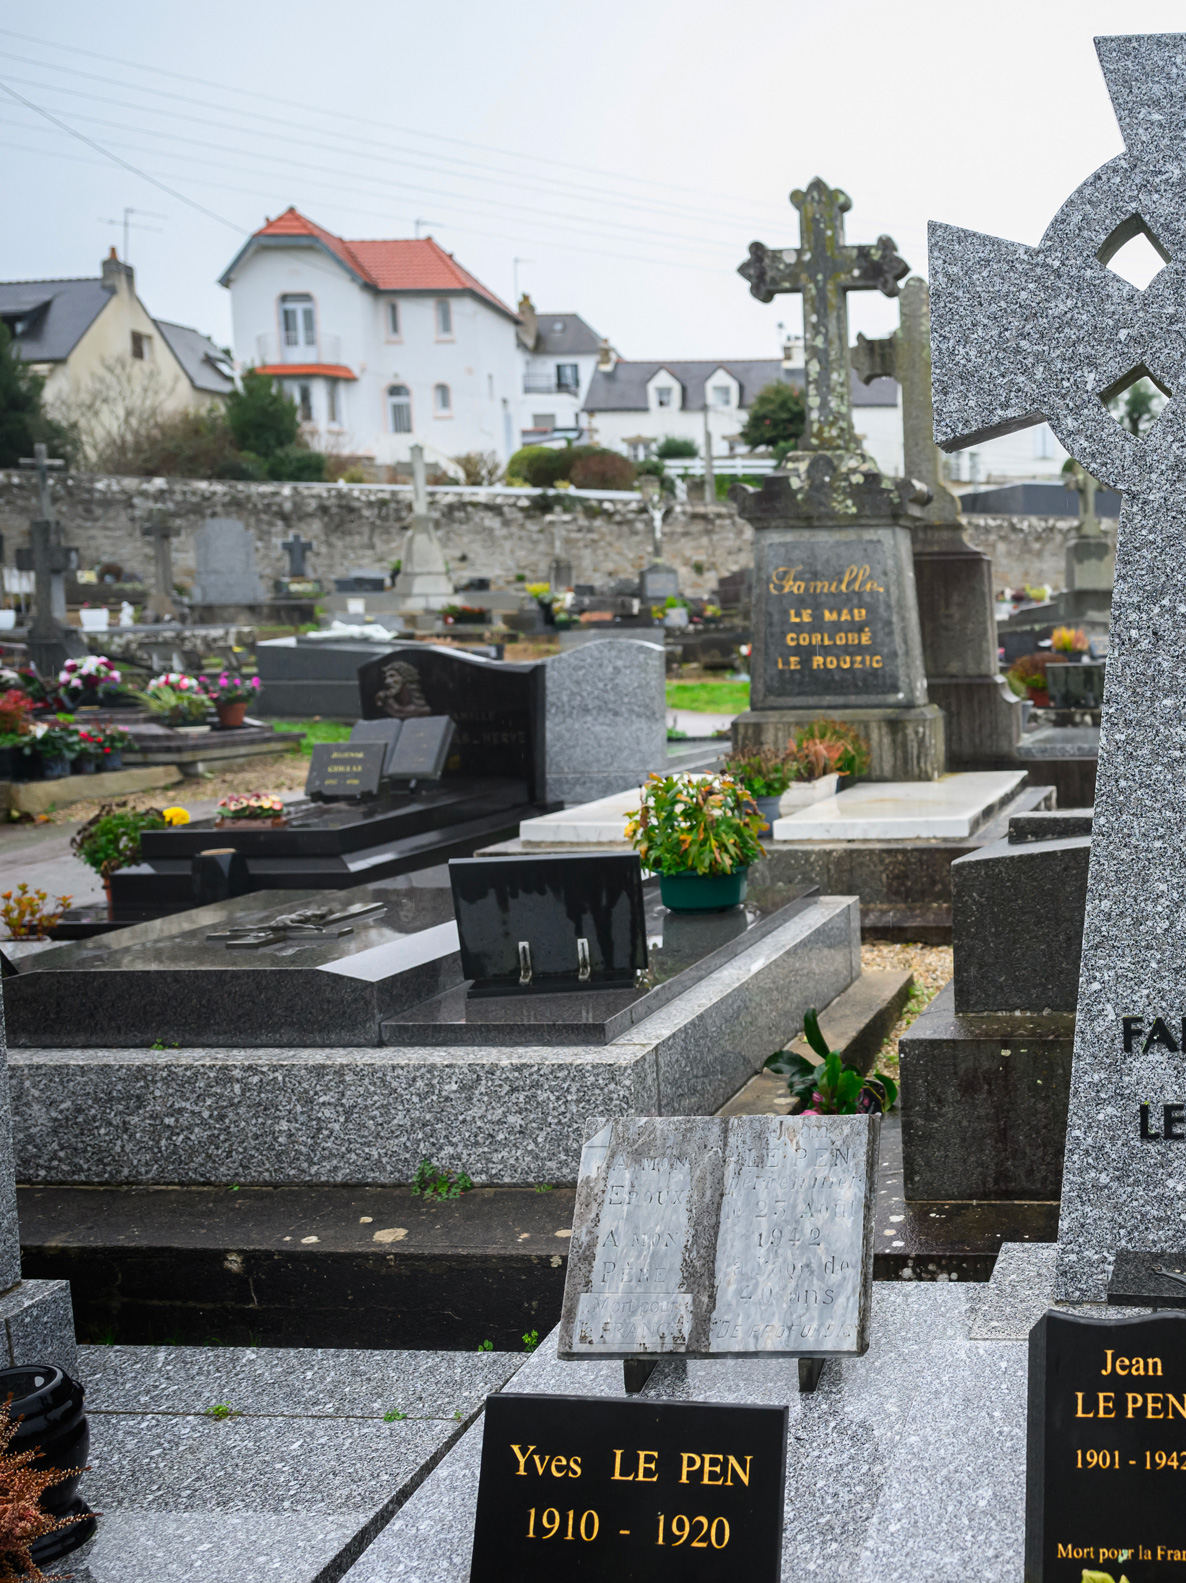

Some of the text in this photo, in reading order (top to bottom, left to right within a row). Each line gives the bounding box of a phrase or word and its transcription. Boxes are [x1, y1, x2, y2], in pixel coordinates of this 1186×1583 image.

[769, 564, 885, 595] Famille
[789, 608, 812, 622] LE
[786, 627, 872, 646] CORLOBÉ
[778, 655, 883, 670] LE ROUZIC
[1139, 1103, 1185, 1140] LE
[793, 1148, 851, 1168] PEN
[755, 1200, 786, 1219] 23
[631, 1232, 679, 1248] MON
[758, 1227, 821, 1249] 1942
[789, 1288, 835, 1306] ans
[1101, 1349, 1164, 1377] Jean
[1075, 1392, 1116, 1419] LE
[510, 1444, 753, 1487] Yves LE PEN
[1075, 1449, 1121, 1470] 1901
[525, 1507, 600, 1541] 1910
[655, 1514, 731, 1549] 1920
[1057, 1543, 1095, 1559] Mort
[1099, 1547, 1135, 1563] pour
[1139, 1545, 1152, 1560] la
